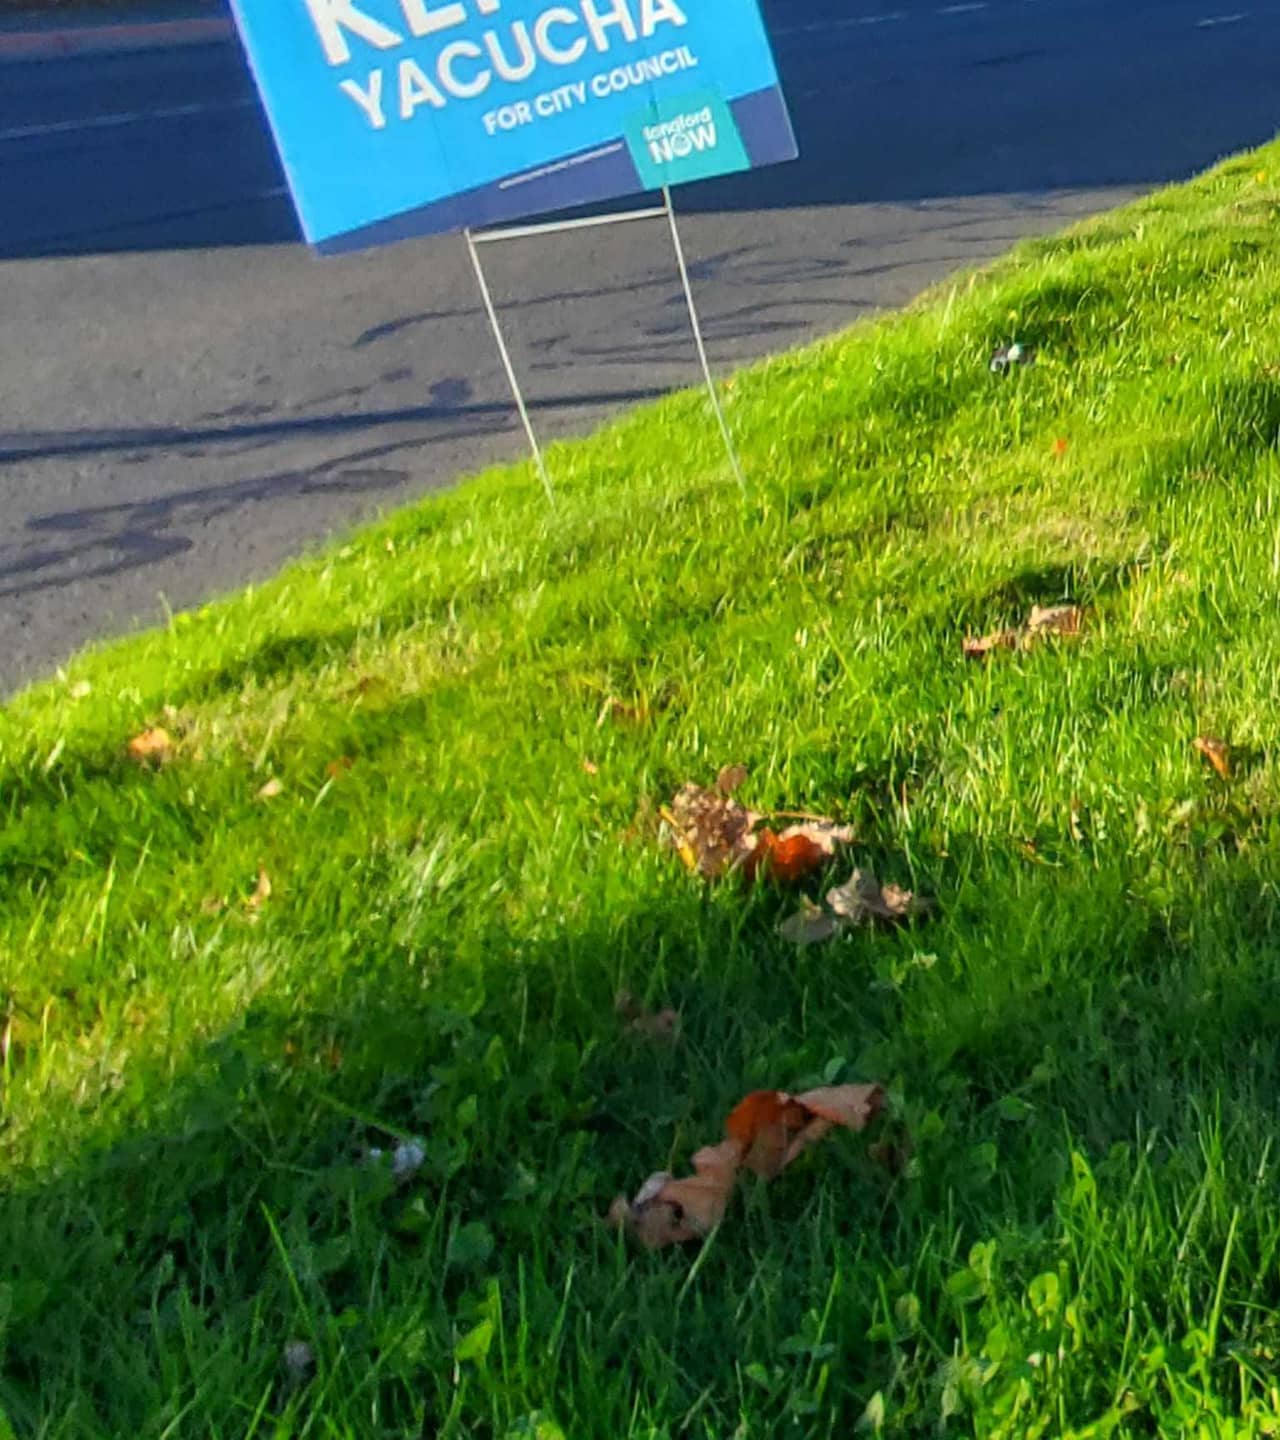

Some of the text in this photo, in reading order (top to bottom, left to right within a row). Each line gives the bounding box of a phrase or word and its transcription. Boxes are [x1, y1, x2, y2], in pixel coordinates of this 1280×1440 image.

[482, 46, 698, 135] FOR CITY COUNCIL
[650, 122, 717, 164] NOW
